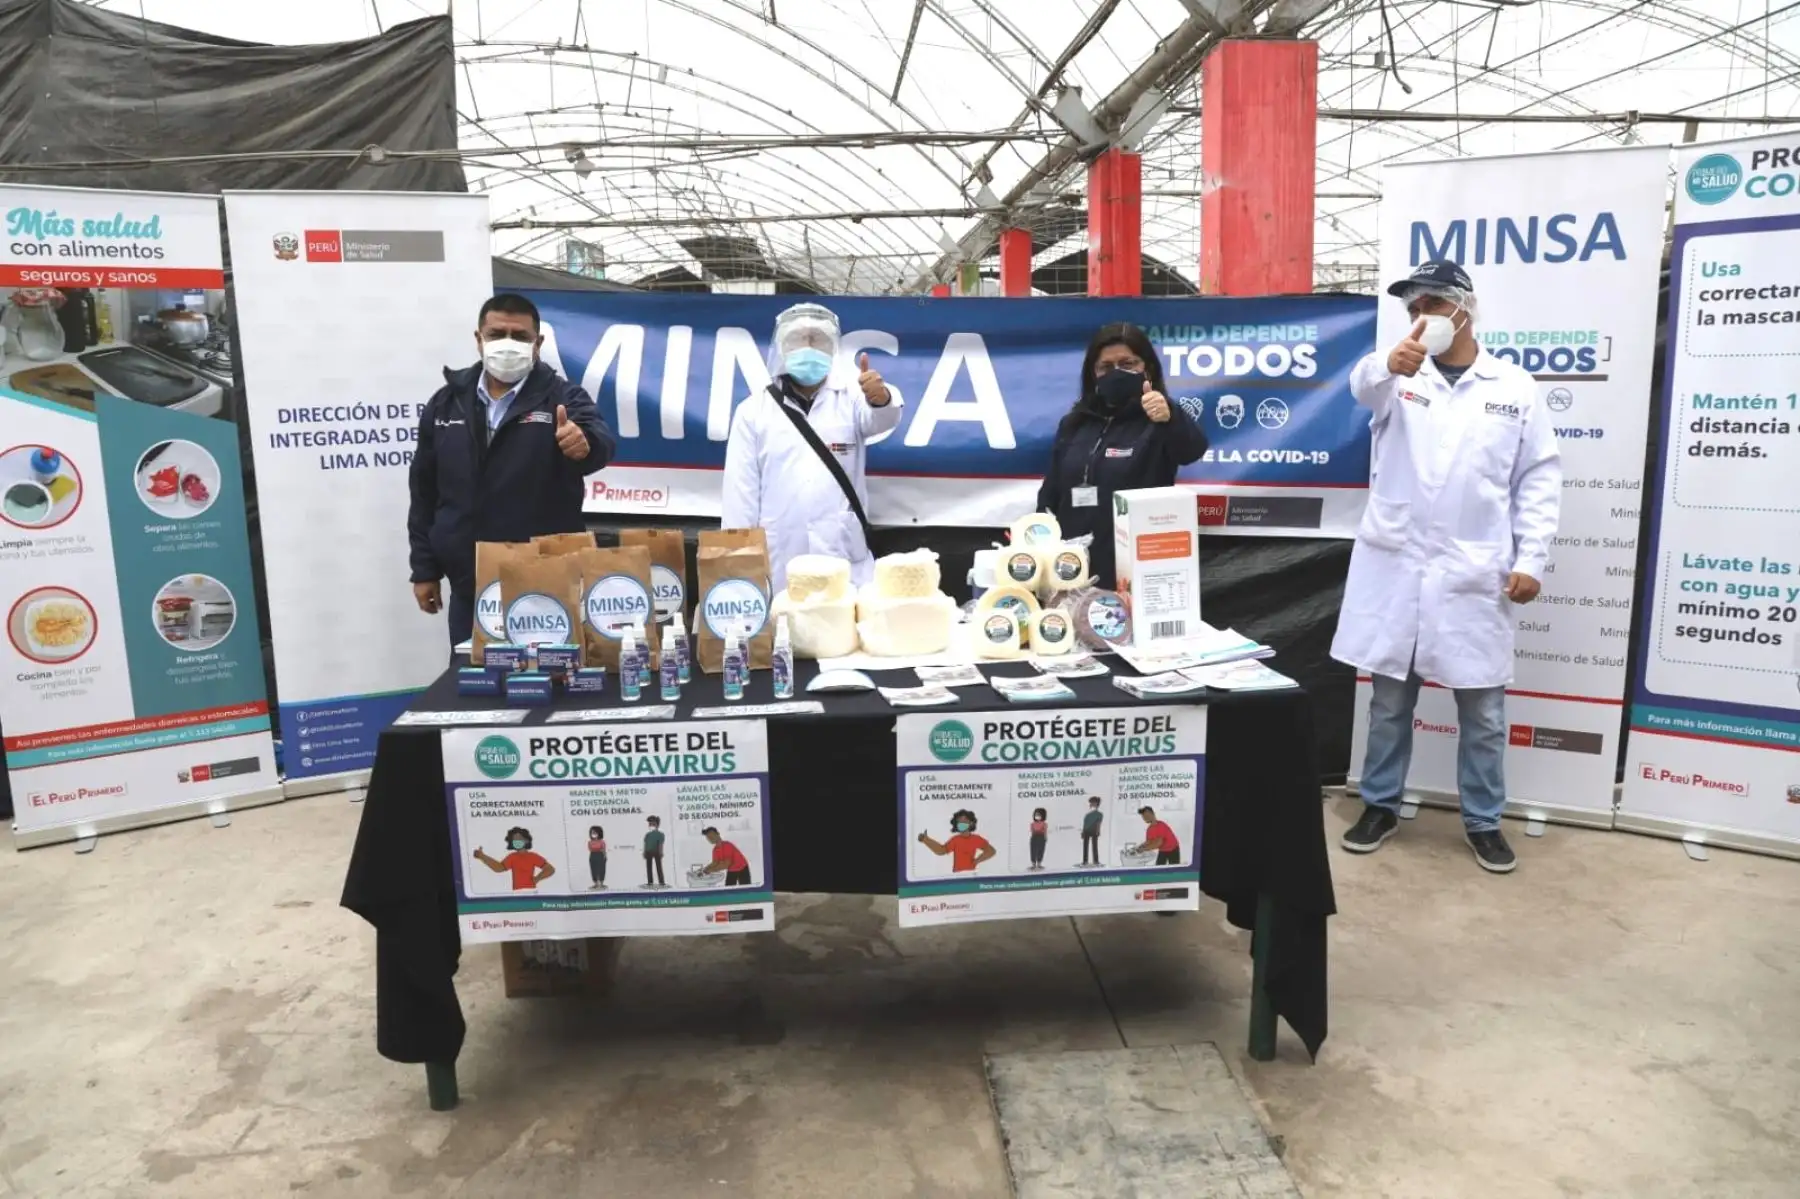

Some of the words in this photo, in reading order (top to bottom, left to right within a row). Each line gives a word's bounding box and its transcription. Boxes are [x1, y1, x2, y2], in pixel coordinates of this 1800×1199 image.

[1702, 173, 1738, 188] SALUD
[6, 207, 74, 240] Más
[82, 212, 162, 239] salud
[346, 242, 391, 251] Ministerio
[1410, 212, 1627, 267] MINSA
[10, 241, 52, 256] con
[58, 240, 165, 259] alimentos
[308, 241, 339, 253] PERÚ
[359, 250, 384, 259] Salud
[20, 268, 91, 285] seguros
[95, 272, 104, 284] y
[108, 271, 157, 283] sanos
[1701, 262, 1741, 278] Usa
[1697, 309, 1715, 326] la
[1213, 325, 1318, 342] DEPENDE
[1514, 331, 1599, 344] DEPENDE
[1163, 344, 1318, 378] TODOS
[1486, 347, 1596, 373] ODOS
[1692, 393, 1777, 411] Mantén
[278, 401, 381, 424] DIRECCIÓN
[387, 403, 410, 419] DE
[1690, 417, 1790, 434] distancia
[270, 428, 390, 449] INTEGRADAS
[395, 427, 420, 442] DE
[1554, 428, 1603, 439] VID-19
[1688, 440, 1768, 458] demás.
[320, 453, 369, 470] LIMA
[374, 451, 415, 467] NOR
[1219, 451, 1243, 463] LA
[1247, 450, 1330, 464] COVID-19
[1589, 478, 1604, 489] de
[1608, 478, 1640, 490] Salud
[1198, 505, 1224, 516] PERÚ
[1584, 536, 1600, 547] de
[1603, 537, 1635, 549] Salud
[1683, 553, 1753, 572] Lávate
[1760, 557, 1791, 575] las
[652, 585, 681, 598] NSA
[1680, 578, 1718, 593] con
[1725, 583, 1779, 600] agua
[1787, 587, 1800, 603] y
[590, 596, 646, 613] MINSA
[708, 599, 764, 616] MINSA
[1579, 596, 1593, 607] de
[1597, 597, 1630, 609] Salud
[1678, 601, 1759, 621] mínimo
[1767, 606, 1797, 623] 20
[509, 614, 567, 630] MINSA
[1518, 621, 1550, 633] Salud
[1675, 624, 1782, 646] segundos
[1514, 649, 1571, 663] Ministerio
[1574, 654, 1588, 664] de
[1593, 655, 1625, 667] Salud
[17, 672, 53, 682] Cocina
[983, 715, 1127, 741] PROTÉGETE
[1133, 715, 1177, 734] DEL
[1648, 713, 1670, 725] Para
[1673, 716, 1694, 728] más
[1697, 719, 1762, 737] información
[1765, 730, 1797, 741] llama
[529, 730, 682, 757] PROTÉGETE
[687, 731, 735, 751] DEL
[942, 738, 971, 749] SALUD
[981, 735, 1177, 763] CORONAVIRUS
[488, 754, 518, 765] SALUD
[529, 752, 737, 780] CORONAVIRUS
[1063, 770, 1092, 778] METRO
[1150, 765, 1164, 773] LAS
[1119, 775, 1148, 783] MANOS
[1171, 772, 1194, 780] AGUA
[616, 787, 647, 796] METRO
[710, 783, 726, 791] LAS
[919, 783, 993, 792] CORRECTAMENTE
[1018, 782, 1029, 790] DE
[1031, 780, 1075, 789] DISTANCIA
[677, 794, 710, 802] MANOS
[712, 792, 731, 800] CON
[733, 791, 758, 800] AGUA
[919, 793, 930, 801] LA
[1018, 791, 1037, 799] CON
[1038, 790, 1054, 798] LOS
[470, 800, 544, 808] CORRECTAMENTE
[584, 798, 630, 807] DISTANCIA
[471, 810, 482, 818] LA
[571, 808, 590, 816] CON
[592, 808, 608, 816] LOS
